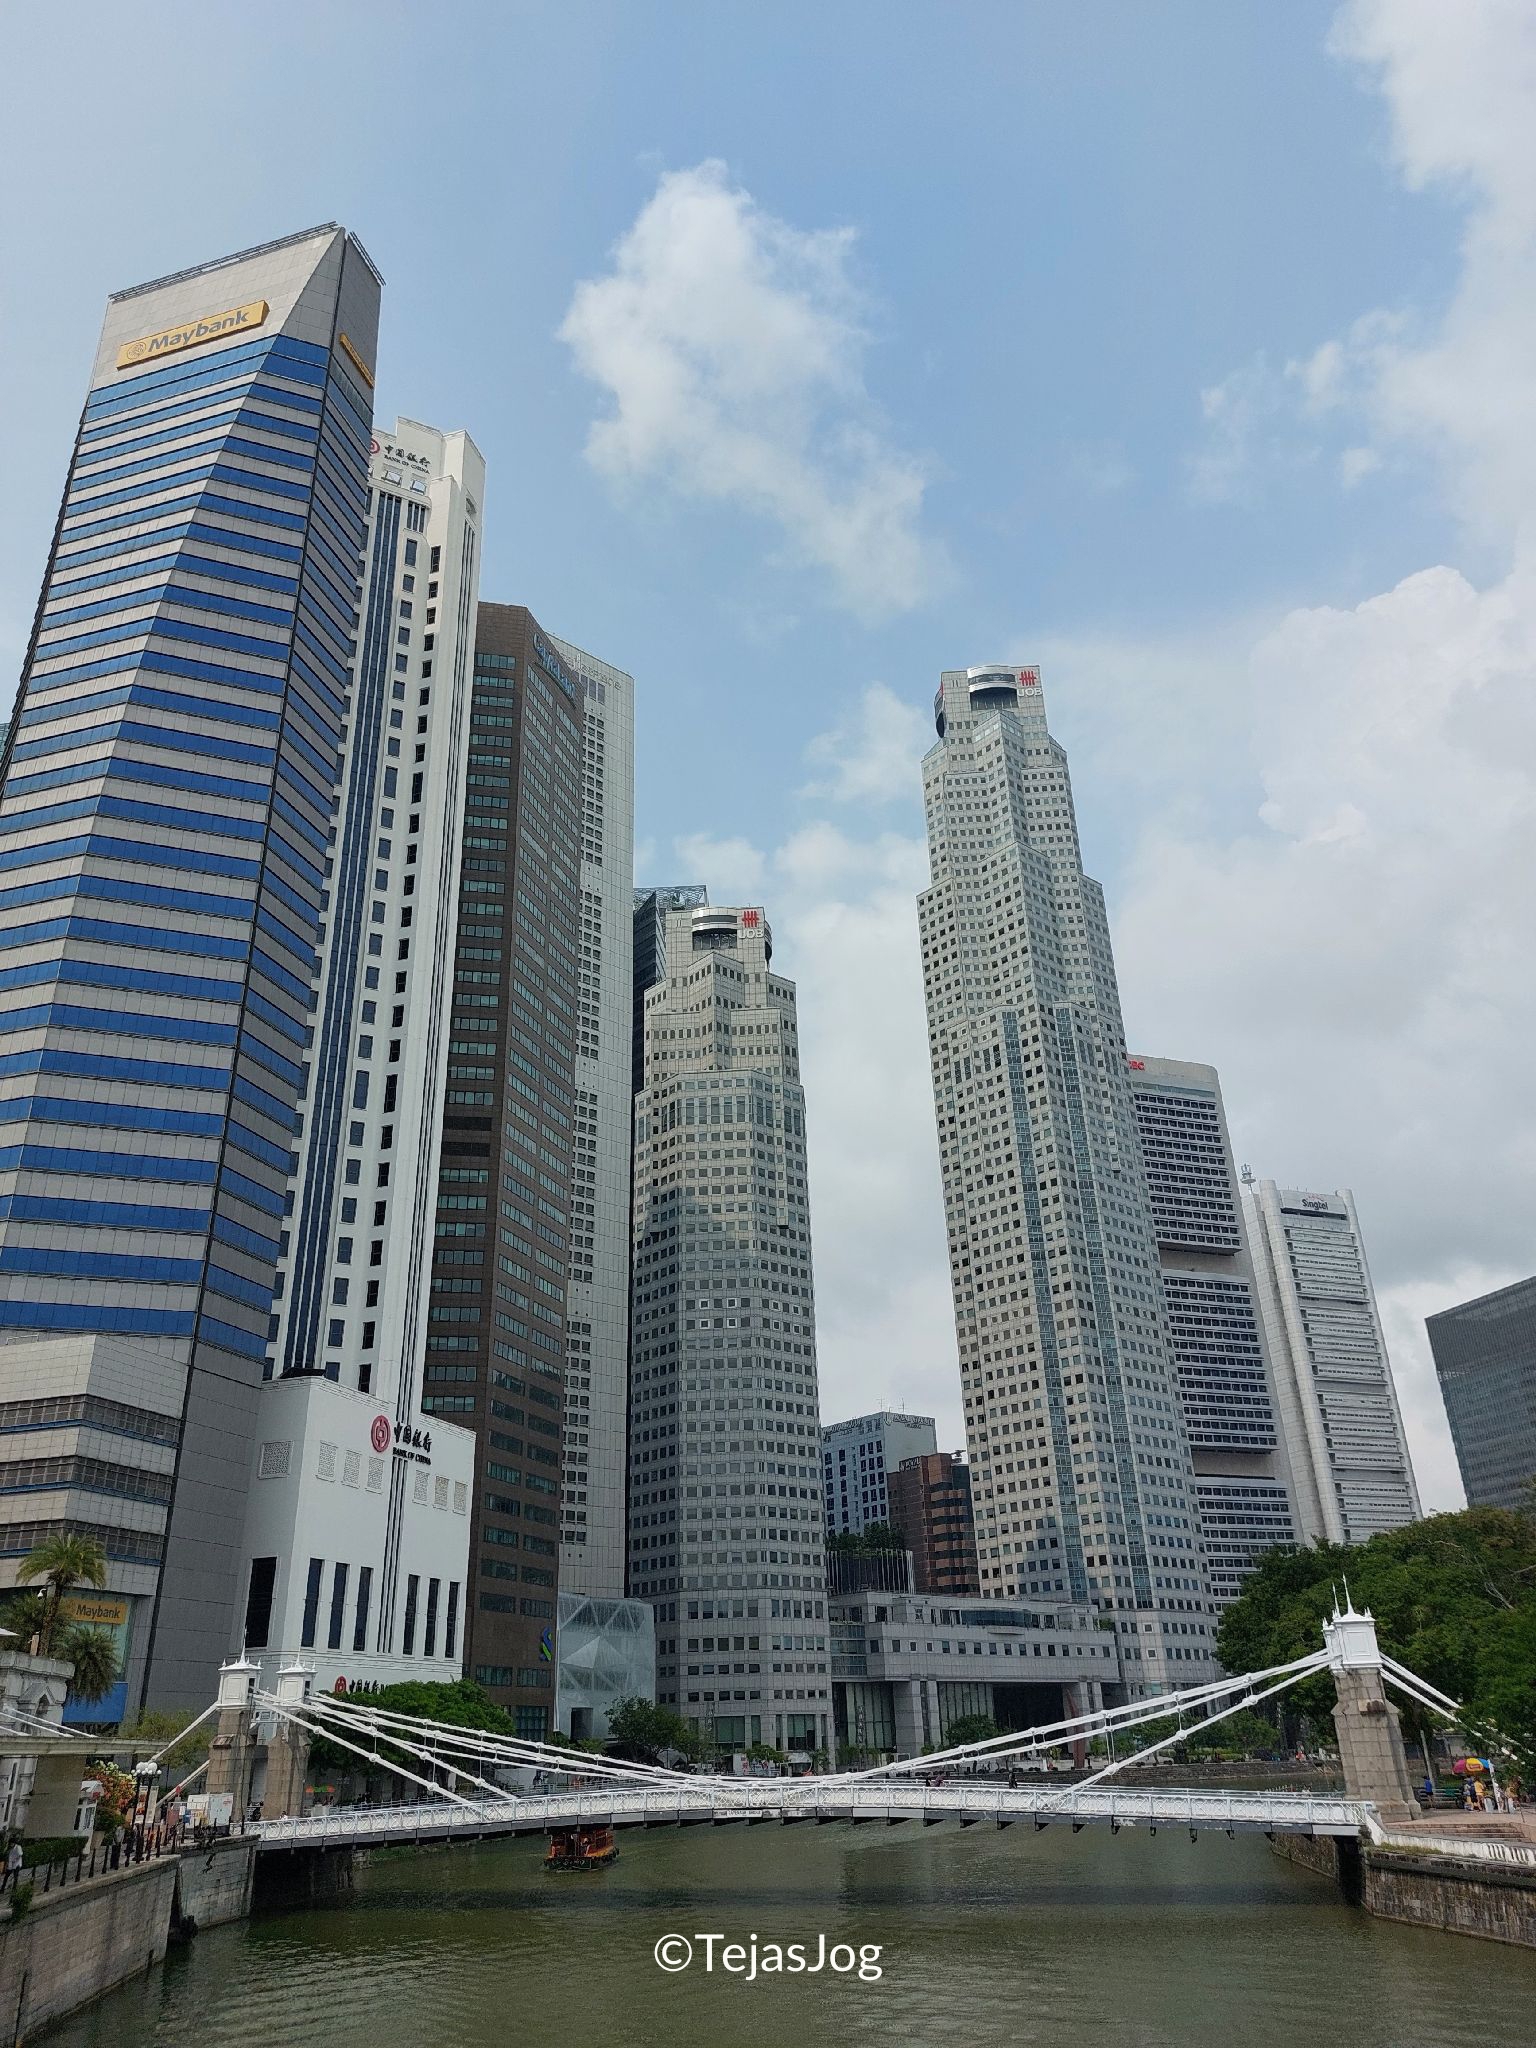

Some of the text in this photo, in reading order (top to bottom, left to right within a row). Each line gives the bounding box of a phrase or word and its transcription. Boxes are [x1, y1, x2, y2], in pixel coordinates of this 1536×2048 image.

[147, 310, 250, 352] Maybank
[1302, 1199, 1328, 1210] Singtel
[393, 1447, 408, 1458] BANK
[415, 1454, 431, 1465] CHINA
[76, 1604, 120, 1619] Maybank
